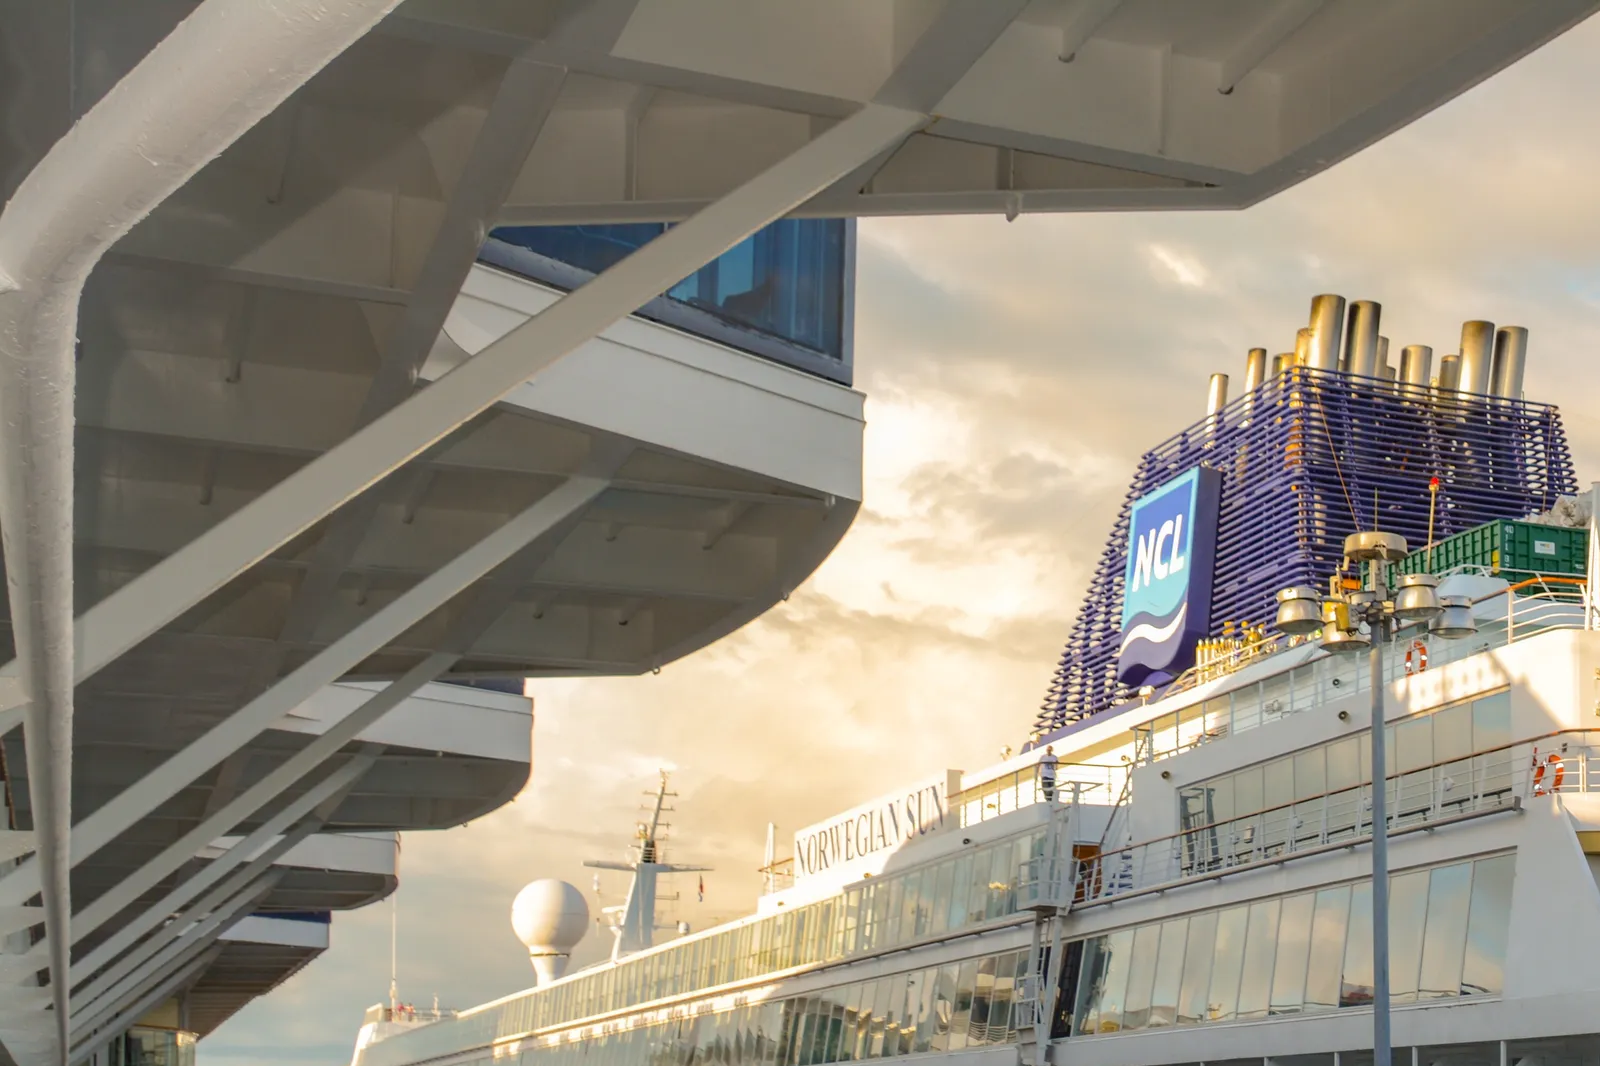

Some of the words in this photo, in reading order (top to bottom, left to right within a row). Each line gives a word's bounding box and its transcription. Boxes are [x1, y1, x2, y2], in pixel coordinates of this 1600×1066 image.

[1132, 513, 1185, 593] NCL
[796, 799, 901, 879] NORWEGIAN
[905, 782, 945, 841] SUN
